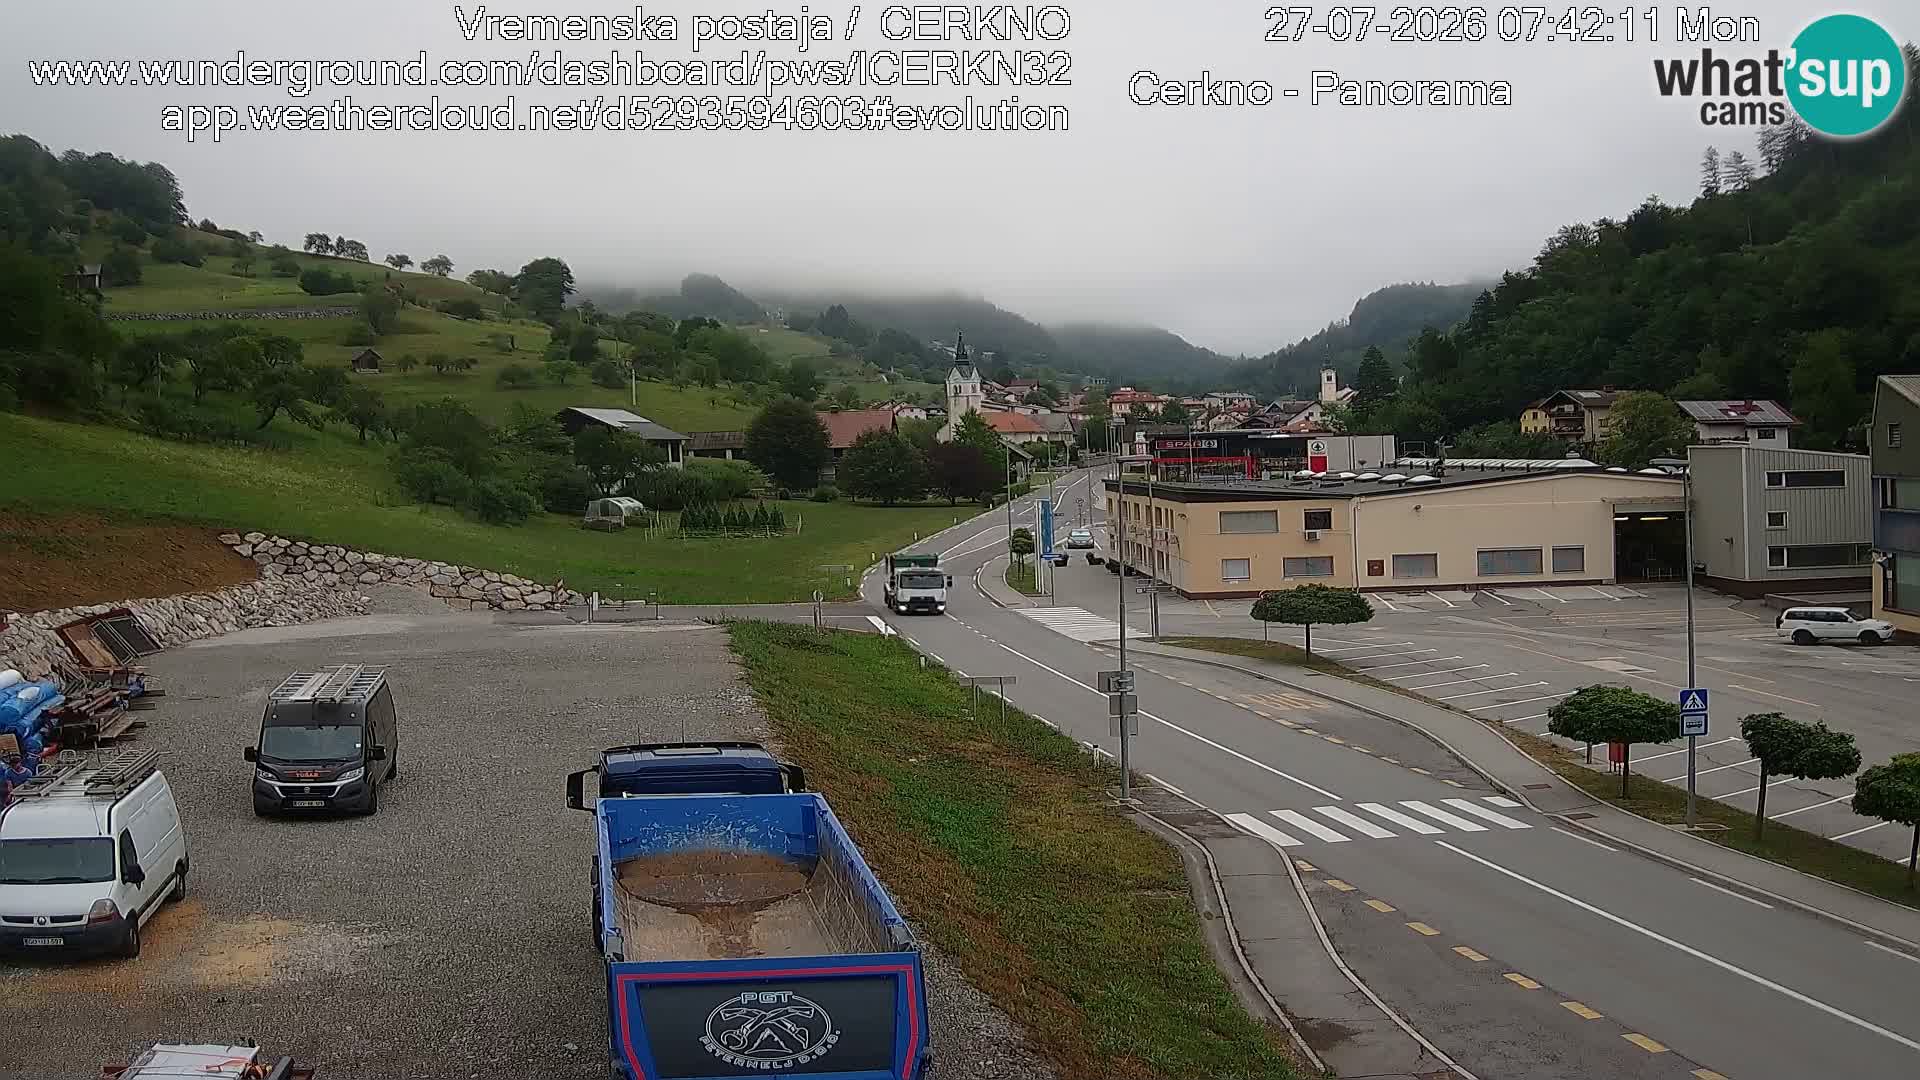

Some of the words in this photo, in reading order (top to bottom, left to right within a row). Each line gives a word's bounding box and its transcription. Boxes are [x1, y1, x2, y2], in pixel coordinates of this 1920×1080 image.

[1166, 440, 1202, 448] SPAR
[741, 991, 793, 1004] PGT
[699, 1035, 793, 1069] PETERNELJ
